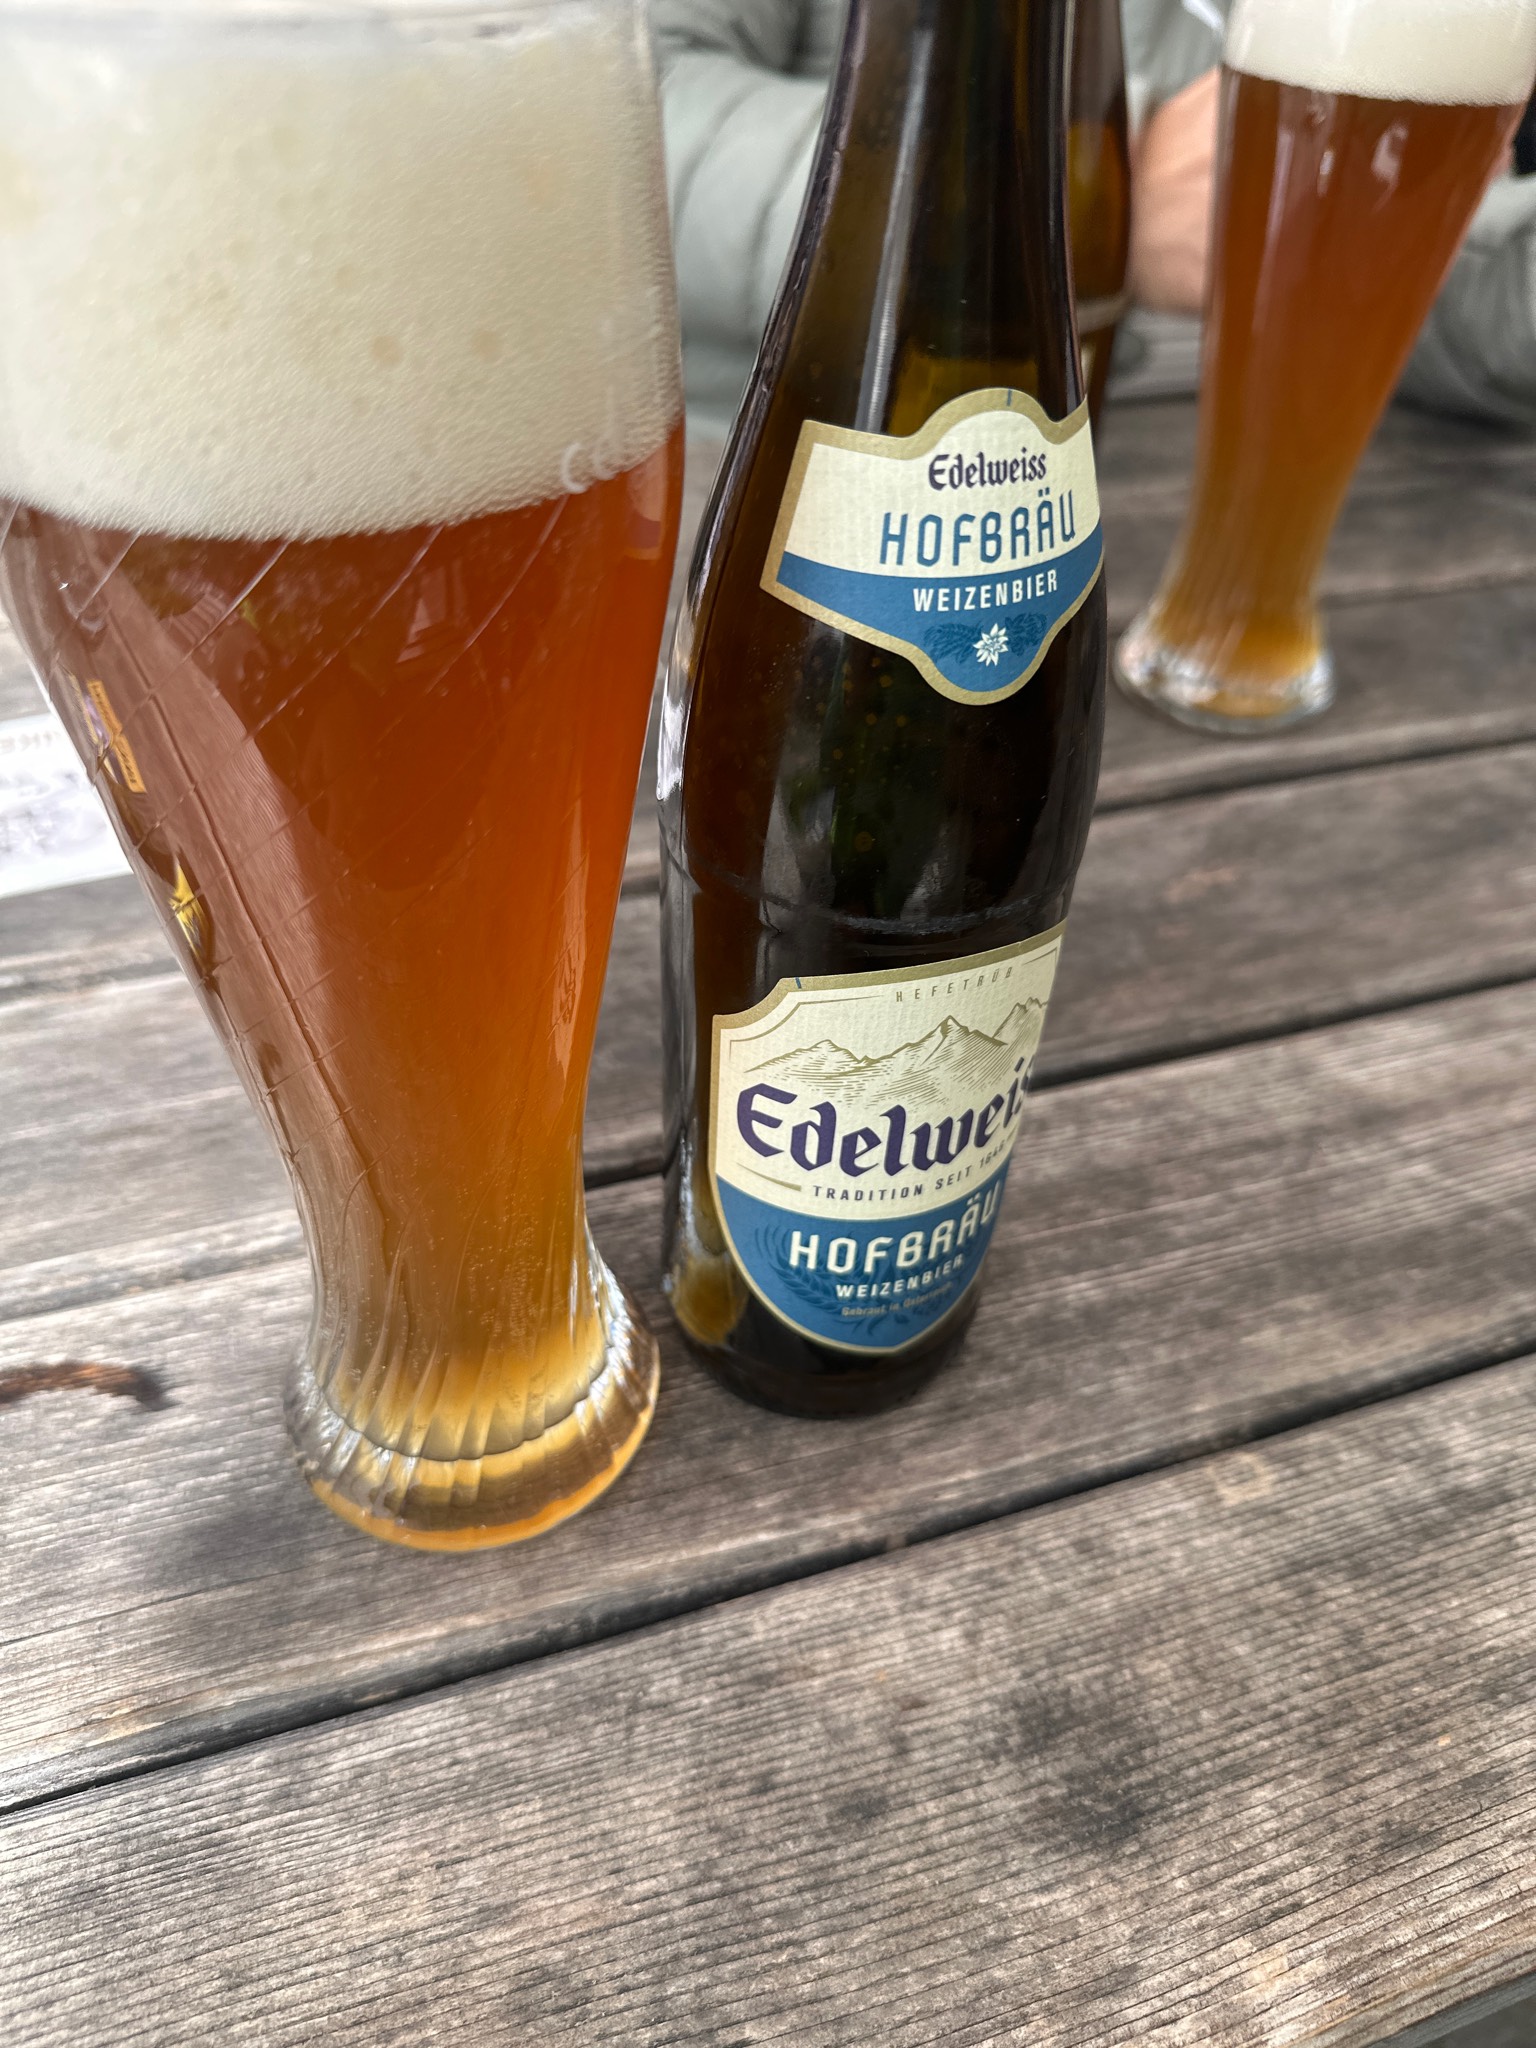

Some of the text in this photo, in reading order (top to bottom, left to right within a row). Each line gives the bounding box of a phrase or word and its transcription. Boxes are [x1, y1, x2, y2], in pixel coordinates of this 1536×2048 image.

[929, 448, 1047, 491] Edelweiss
[880, 488, 1076, 567] HOFBRÄU
[912, 569, 1058, 613] WEIZENBIER
[896, 967, 1014, 1003] HEFETRÜB
[812, 1184, 924, 1201] TRADITION
[935, 1167, 973, 1190] SEIT
[789, 1180, 1001, 1274] HOFBRÄU
[835, 1255, 963, 1299] WEIZENBIER
